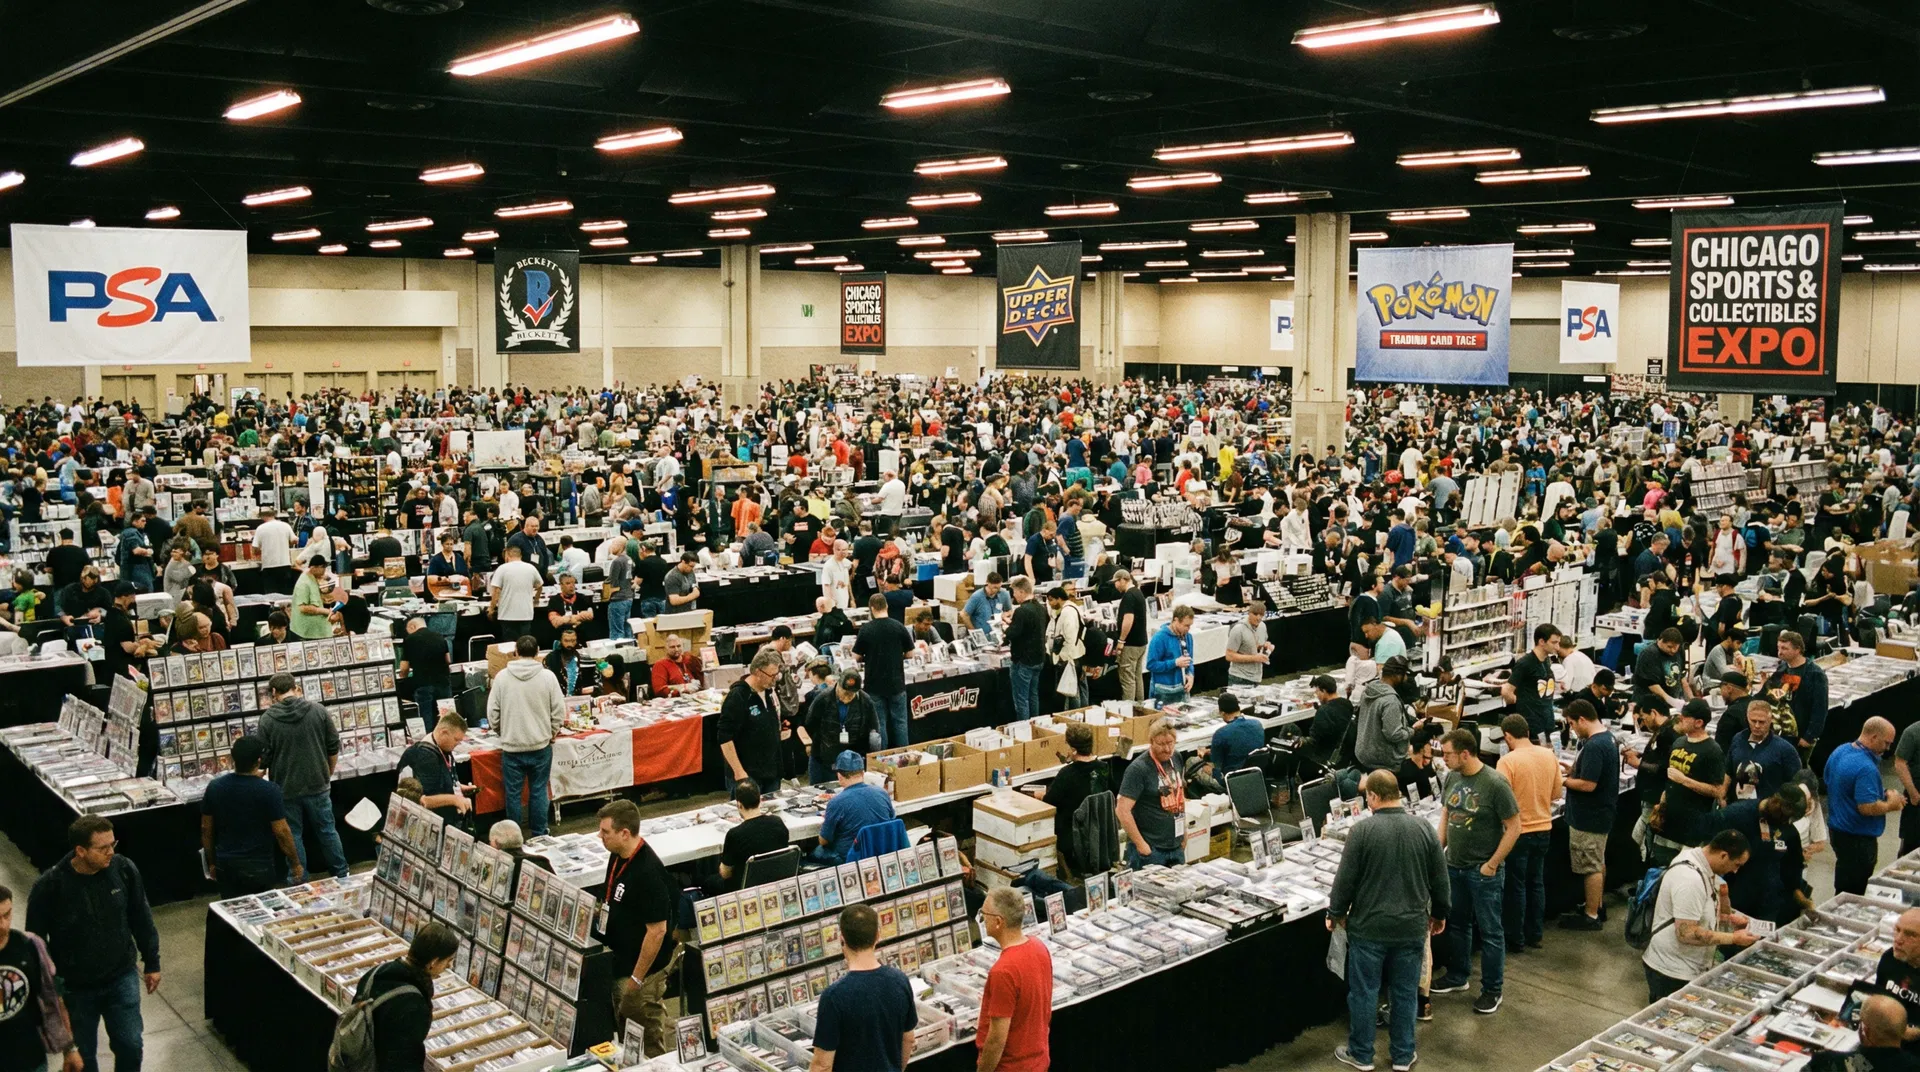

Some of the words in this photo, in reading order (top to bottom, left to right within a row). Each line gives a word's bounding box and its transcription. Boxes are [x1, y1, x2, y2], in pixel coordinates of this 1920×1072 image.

[1690, 233, 1820, 268] CHICAGO
[516, 257, 558, 271] BECKETT
[845, 285, 881, 301] CHICAGO
[1690, 269, 1794, 300] SPORTS
[1797, 269, 1818, 299] &
[48, 267, 218, 328] PSA
[845, 300, 875, 315] SPORTS
[1009, 287, 1067, 309] UPPER
[1689, 302, 1817, 323] COLLECTIBLES
[845, 325, 882, 343] EXPO
[1277, 316, 1294, 335] P
[1567, 306, 1611, 341] PSA
[1688, 327, 1816, 366] EXPO
